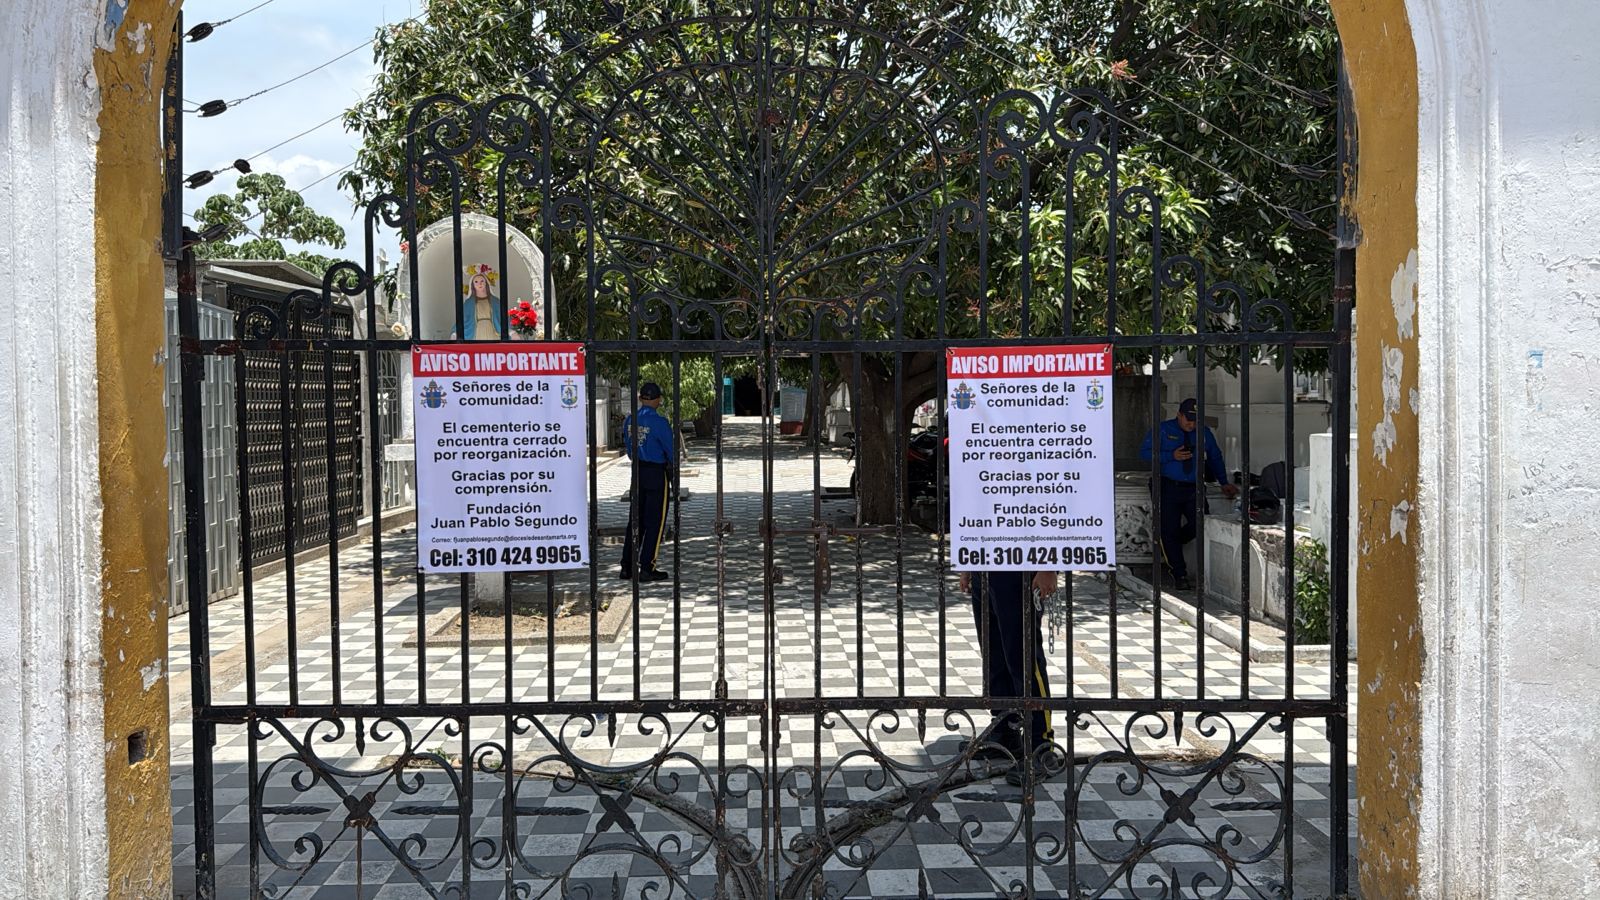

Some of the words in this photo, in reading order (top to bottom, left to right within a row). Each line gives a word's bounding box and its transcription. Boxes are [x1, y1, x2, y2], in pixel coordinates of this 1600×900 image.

[420, 353, 471, 372] AVISO
[475, 352, 578, 372] IMPORTANTE
[951, 356, 998, 374] AVISO
[1003, 353, 1104, 373] IMPORTANTE
[452, 381, 511, 393] Señores
[516, 381, 533, 392] de
[538, 380, 549, 391] la
[981, 383, 1037, 394] Señores
[1042, 382, 1058, 393] de
[1064, 381, 1075, 392] la
[459, 394, 543, 406] comunidad:
[987, 395, 1068, 407] comunidad:
[443, 422, 456, 433] El
[461, 421, 540, 433] cementerio
[545, 422, 560, 431] se
[972, 423, 984, 434] El
[989, 422, 1066, 433] cementerio
[1071, 423, 1086, 432] se
[437, 436, 508, 447] encuentra
[513, 434, 566, 445] cerrado
[966, 437, 1034, 447] encuentra
[1039, 435, 1092, 446] cerrado
[434, 450, 457, 462] por
[462, 448, 571, 462] reorganización.
[962, 450, 985, 462] por
[990, 448, 1096, 462] reorganización.
[452, 470, 505, 481] Gracias
[510, 470, 534, 482] por
[539, 470, 555, 480] su
[979, 470, 1031, 481] Gracias
[1037, 470, 1059, 483] por
[1064, 471, 1080, 480] su
[455, 482, 552, 496] comprensión.
[983, 483, 1077, 496] comprensión.
[467, 503, 541, 514] Fundación
[994, 503, 1066, 514] Fundación
[431, 518, 464, 528] Juan
[471, 516, 510, 527] Pablo
[515, 514, 577, 529] Segundo
[959, 517, 992, 528] Juan
[997, 516, 1036, 527] Pablo
[1040, 516, 1103, 529] Segundo
[430, 549, 463, 567] Cel:
[467, 548, 496, 566] 310
[501, 547, 532, 565] 424
[537, 545, 581, 564] 9965
[958, 547, 989, 565] Cel:
[994, 547, 1023, 565] 310
[1027, 547, 1058, 564] 424
[1062, 547, 1107, 565] 9965
